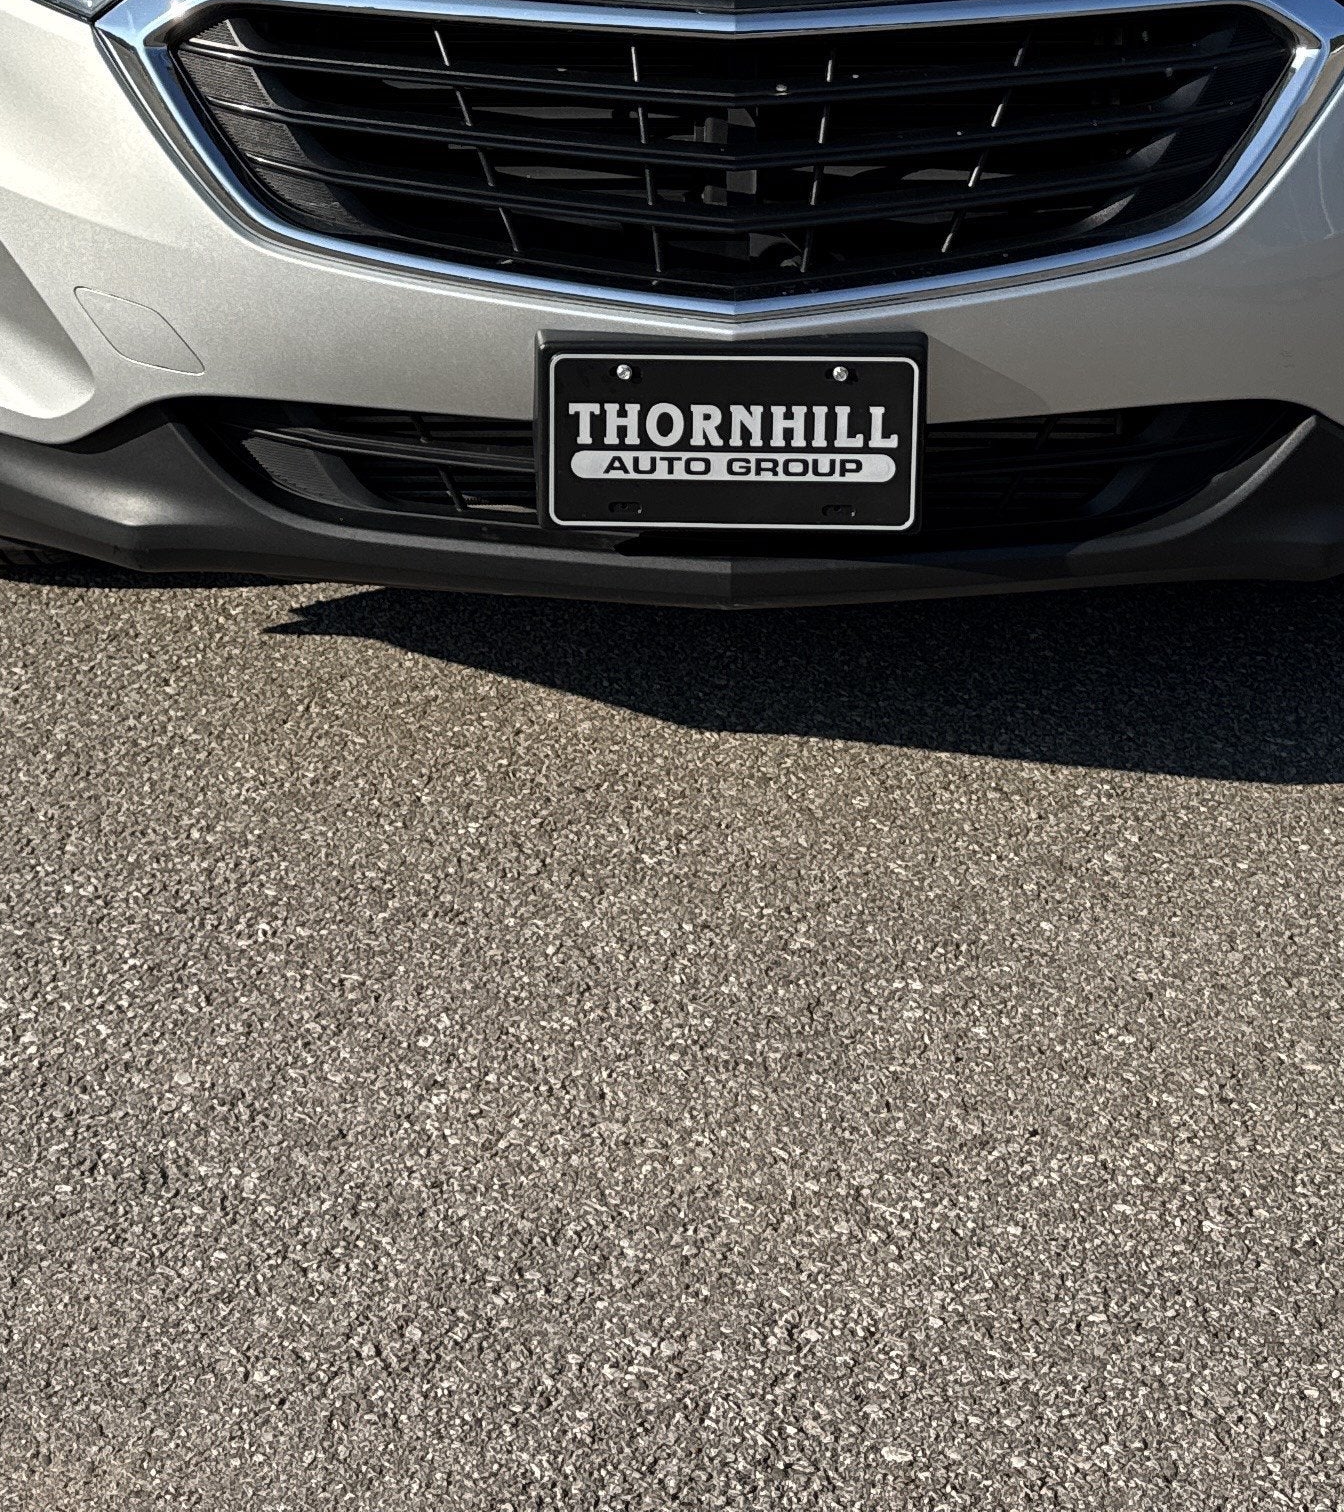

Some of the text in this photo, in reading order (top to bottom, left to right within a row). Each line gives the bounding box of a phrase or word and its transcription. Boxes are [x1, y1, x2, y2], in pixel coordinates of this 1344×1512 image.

[568, 402, 899, 448] THORNHILL
[603, 455, 863, 478] AUTO GROUP
